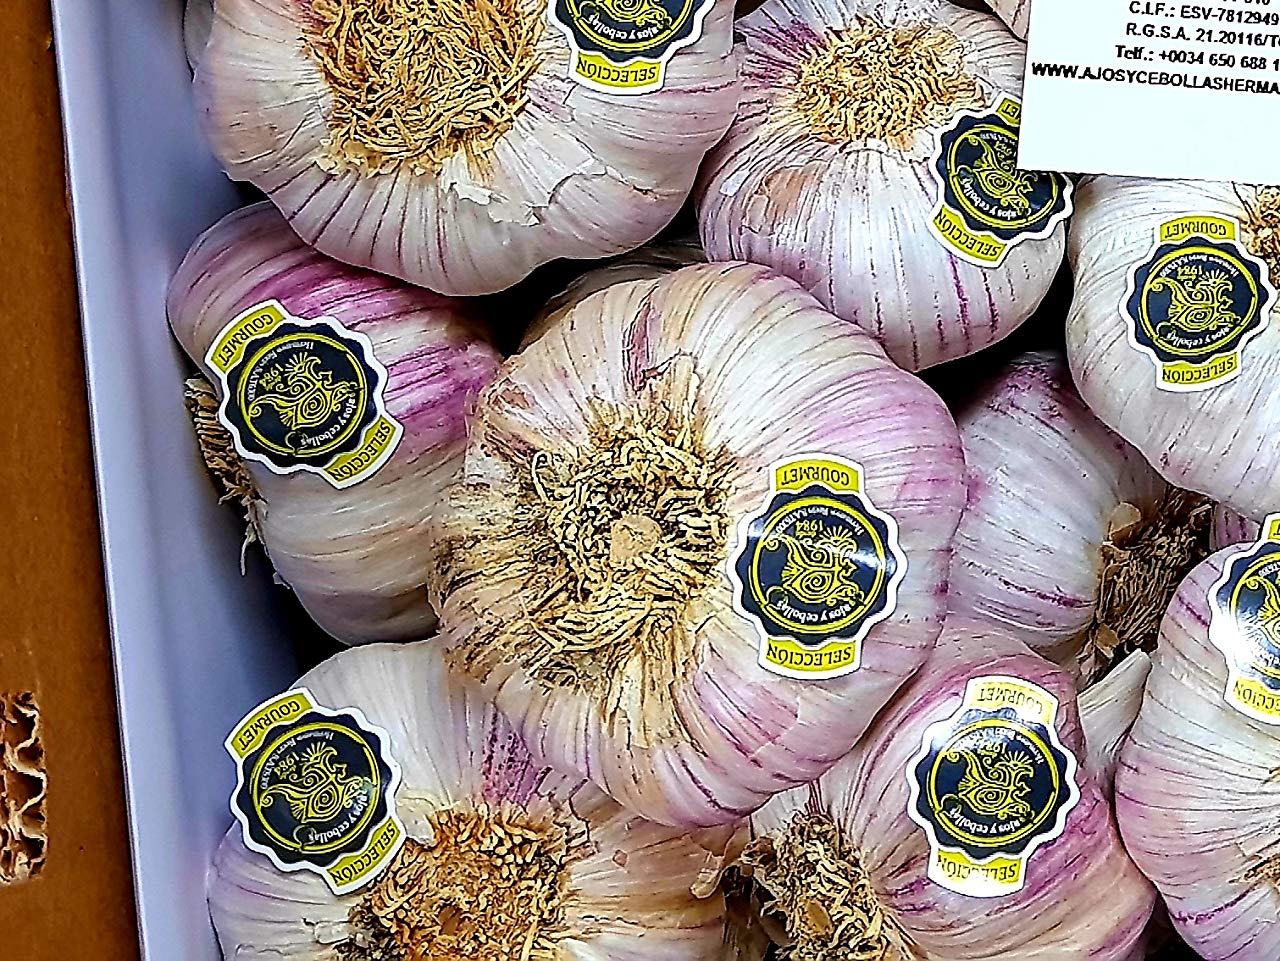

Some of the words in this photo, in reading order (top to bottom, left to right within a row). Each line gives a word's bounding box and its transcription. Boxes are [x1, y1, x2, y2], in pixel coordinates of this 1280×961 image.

[1159, 50, 1204, 64] +0034
[1209, 53, 1235, 67] 650
[1240, 56, 1266, 70] 688
[1165, 222, 1226, 237] GOURMET
[216, 315, 273, 365] GOURMET
[782, 468, 849, 485] GOURMET
[238, 701, 300, 750] GOURMET
